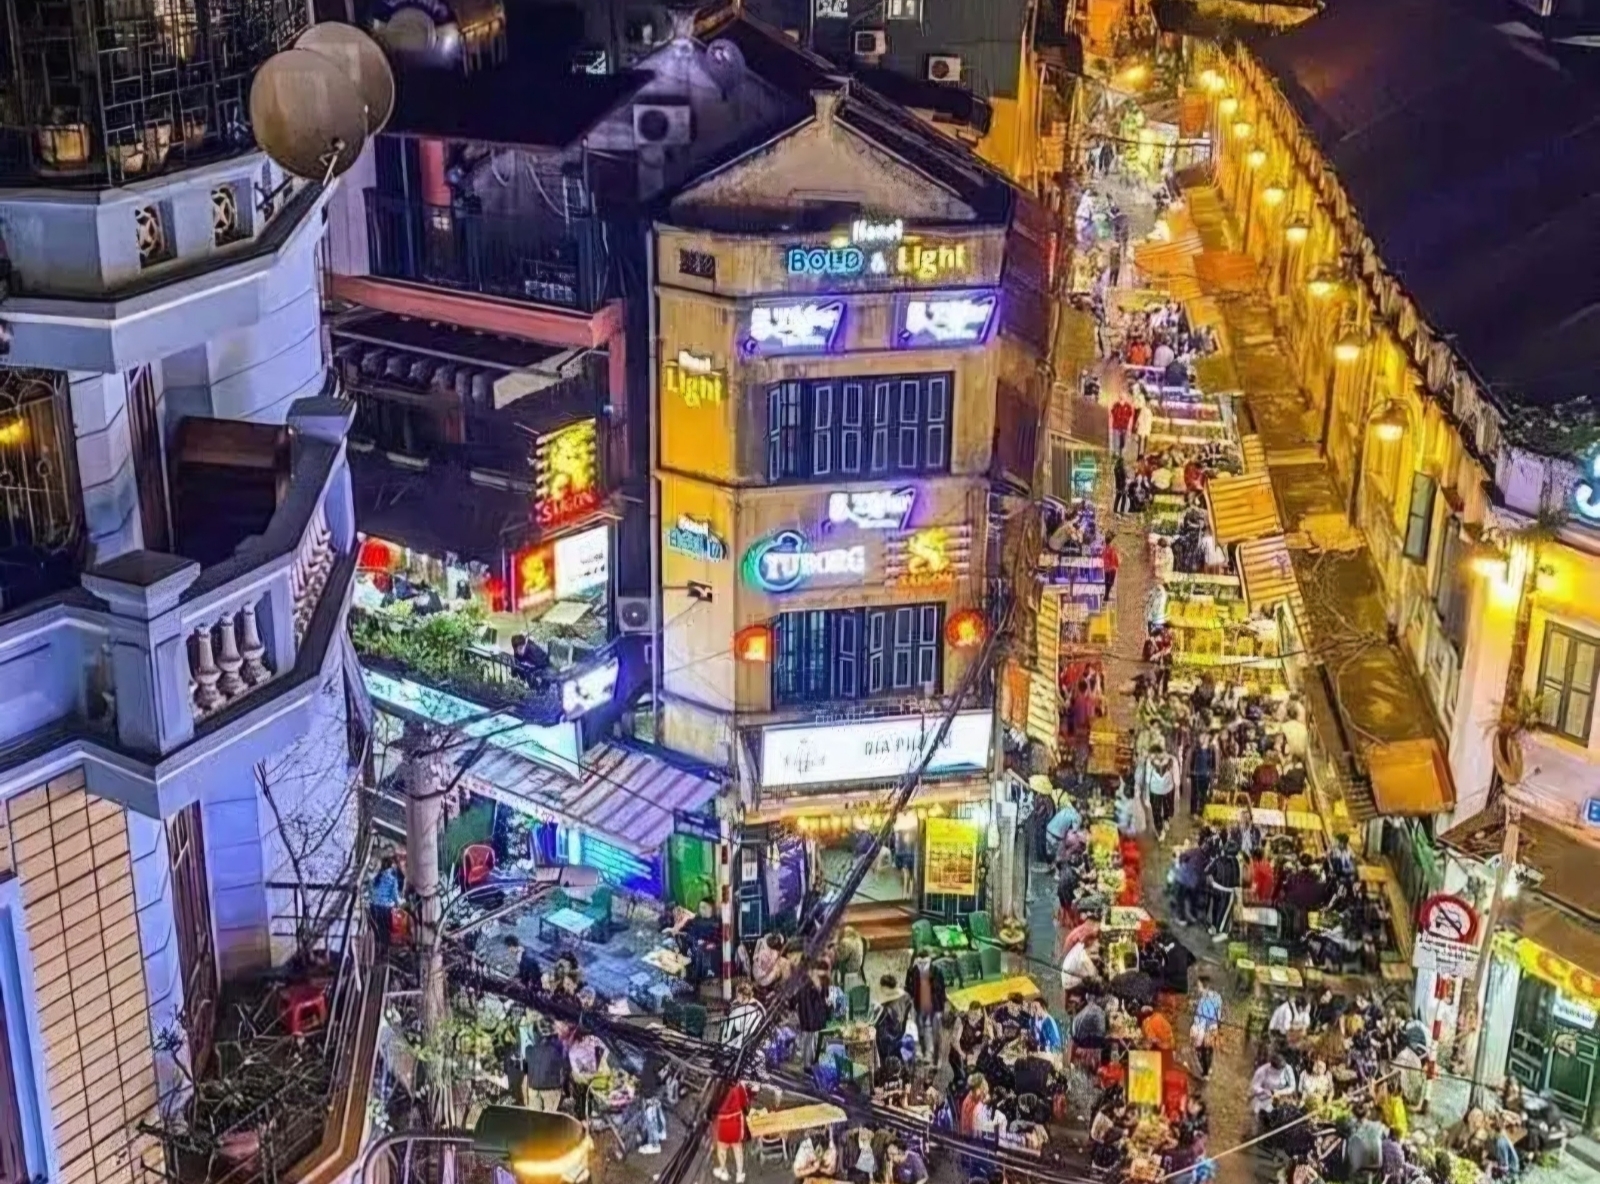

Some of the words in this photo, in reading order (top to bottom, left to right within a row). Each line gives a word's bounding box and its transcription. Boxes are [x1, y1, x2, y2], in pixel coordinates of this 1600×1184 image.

[787, 248, 864, 274] BOLD
[897, 244, 966, 278] Light
[666, 366, 723, 409] Light
